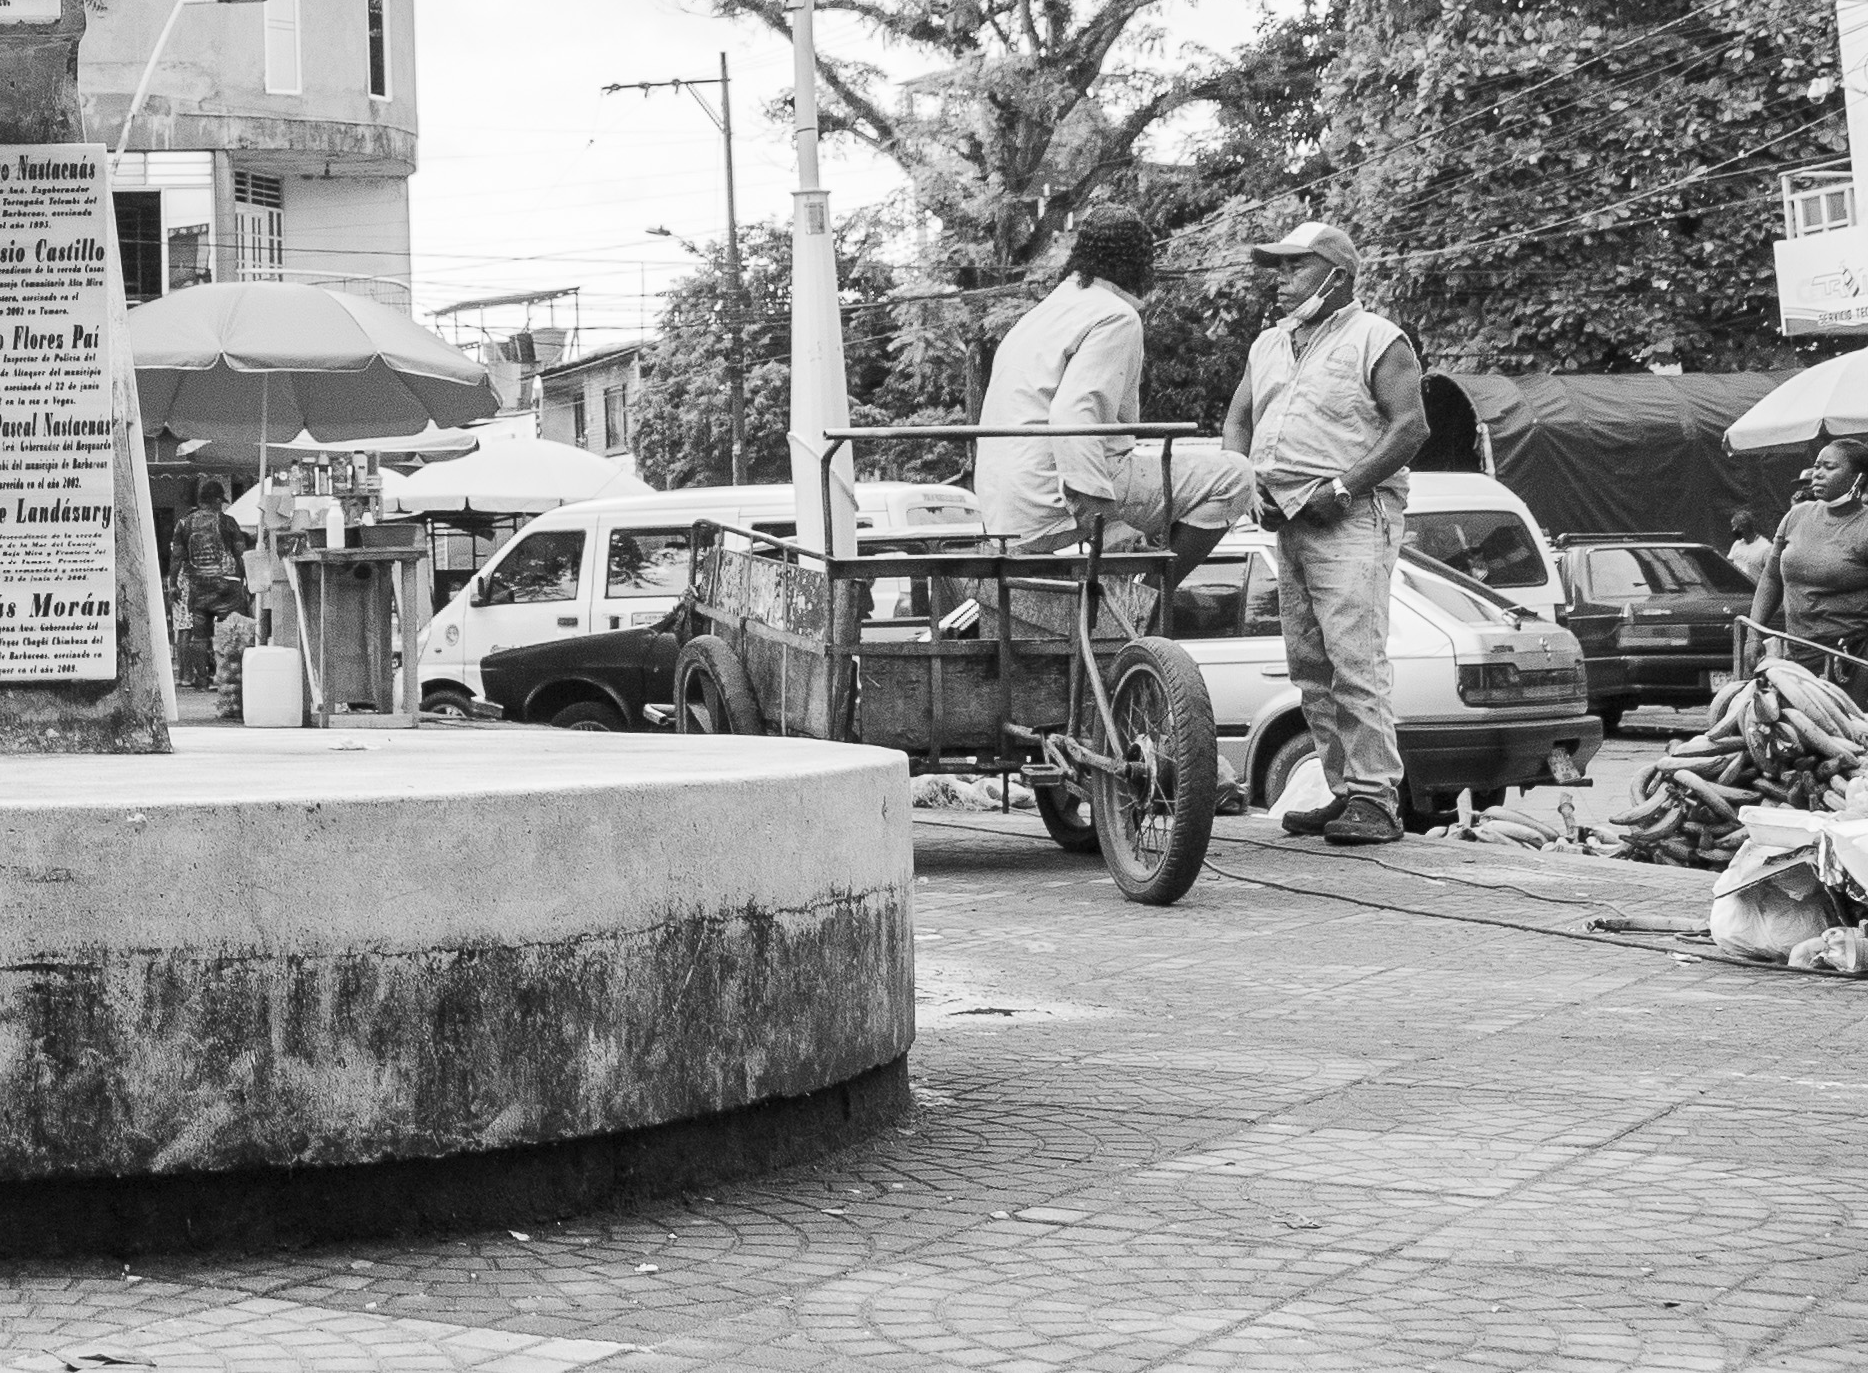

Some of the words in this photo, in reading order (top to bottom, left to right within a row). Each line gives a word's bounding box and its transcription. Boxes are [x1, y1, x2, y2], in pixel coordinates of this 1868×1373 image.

[16, 155, 96, 181] Nastacuás
[35, 238, 105, 263] Castillo
[41, 353, 50, 362] de
[84, 353, 96, 362] del
[43, 412, 110, 437] Nastacuás
[29, 592, 110, 618] Morán
